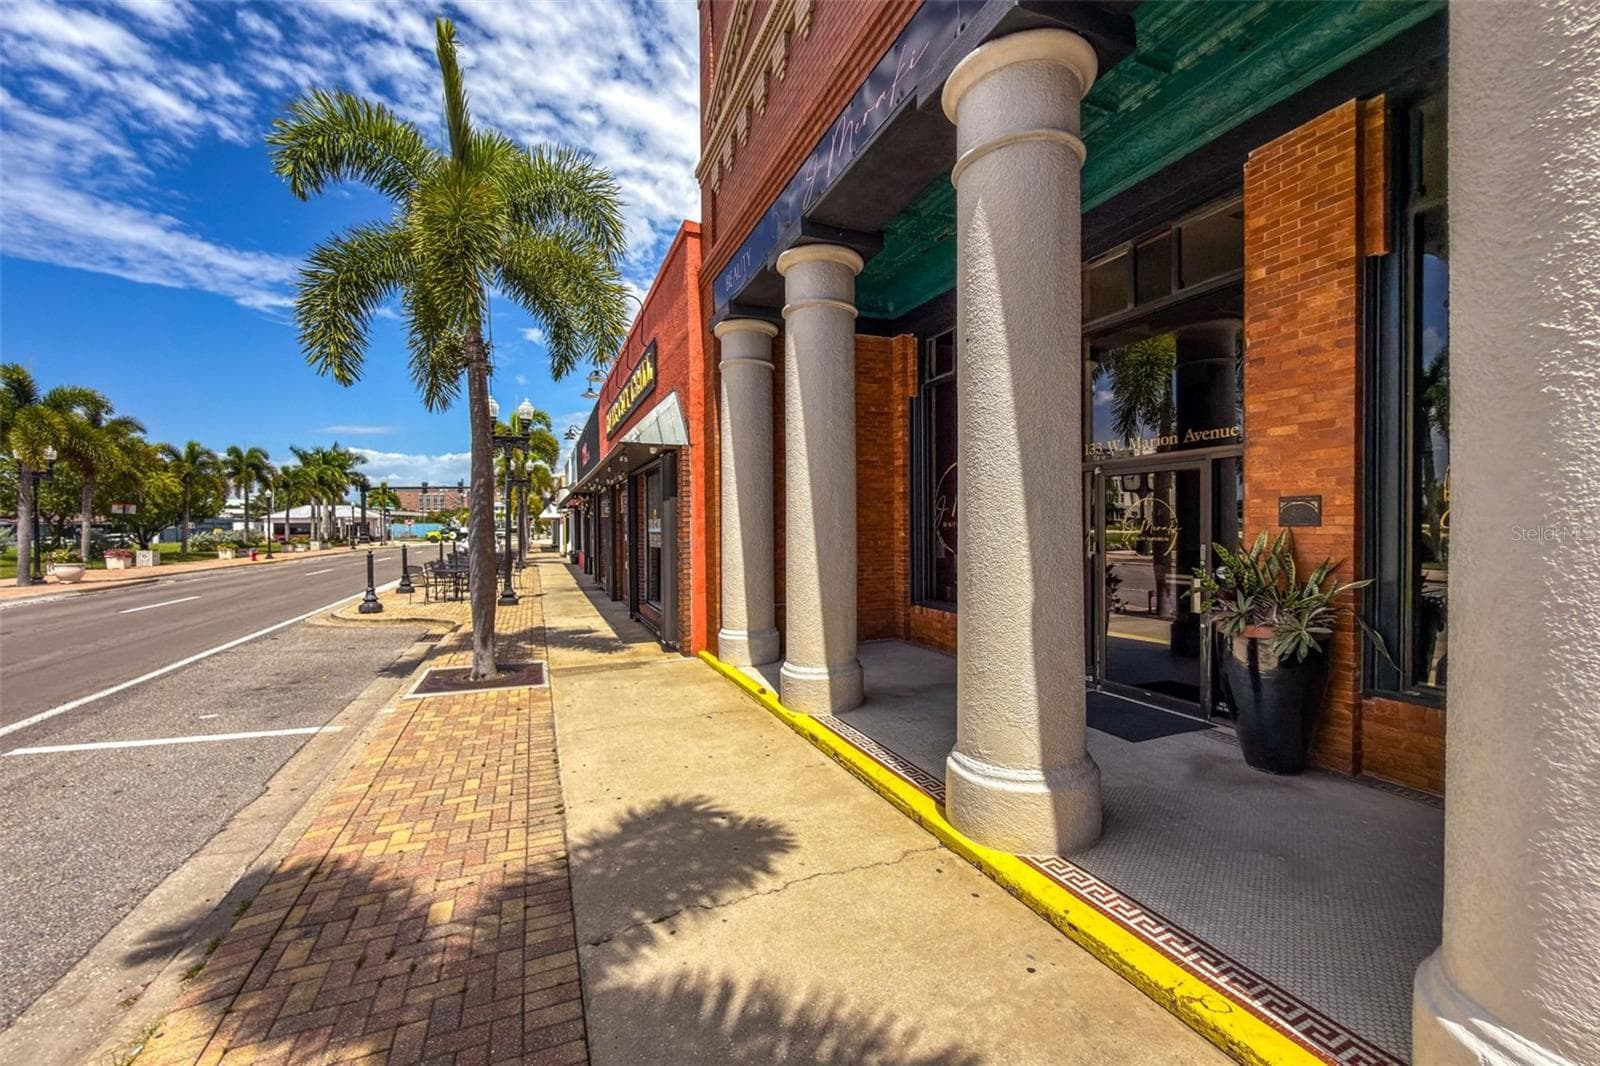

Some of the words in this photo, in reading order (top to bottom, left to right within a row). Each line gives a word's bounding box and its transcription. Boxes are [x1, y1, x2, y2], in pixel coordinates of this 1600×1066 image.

[725, 247, 752, 292] BEAUTY
[1129, 433, 1179, 449] Marion
[1183, 424, 1240, 443] Avenue
